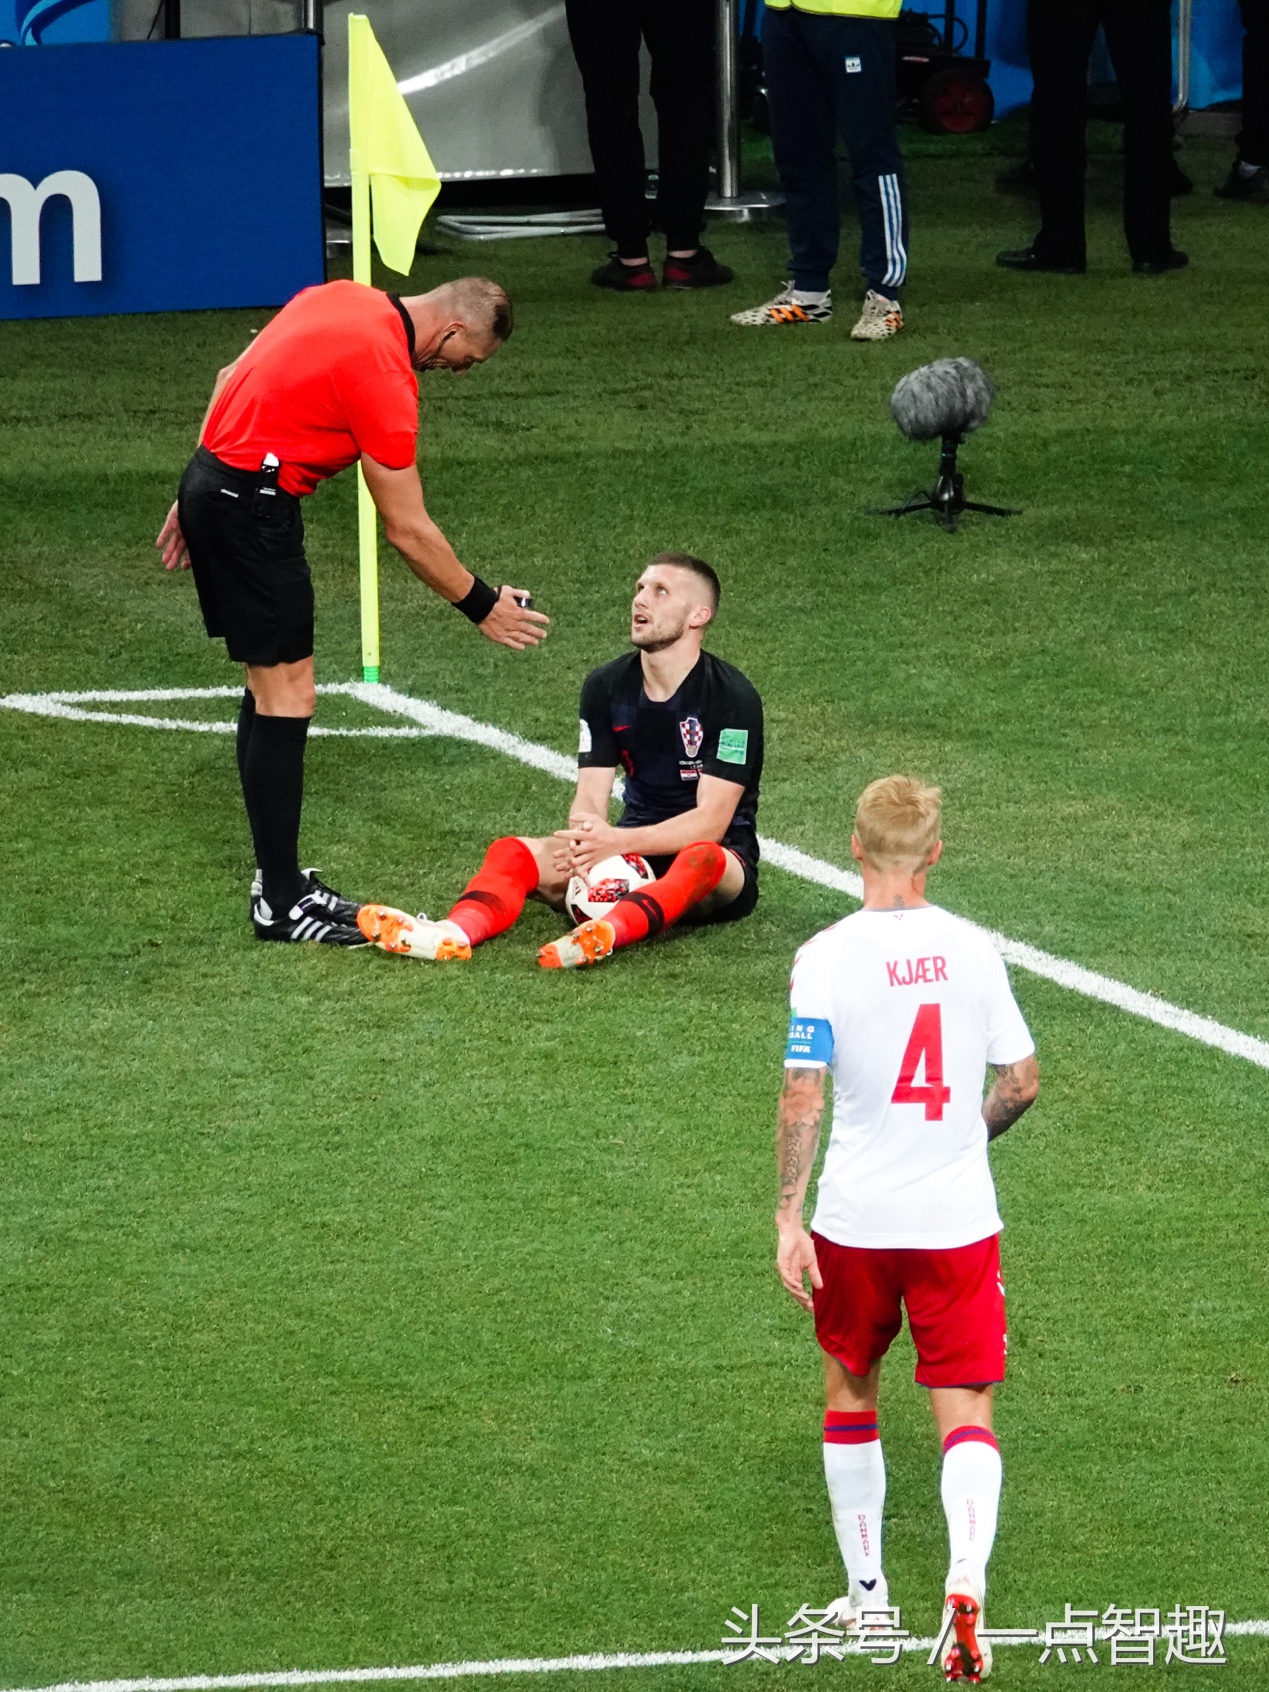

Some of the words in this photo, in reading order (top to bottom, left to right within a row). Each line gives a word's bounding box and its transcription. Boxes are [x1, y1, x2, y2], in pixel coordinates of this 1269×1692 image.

[886, 955, 949, 987] KJÆR
[790, 1044, 811, 1054] FIFA
[891, 1003, 951, 1121] 4
[858, 1514, 870, 1557] DANMARK
